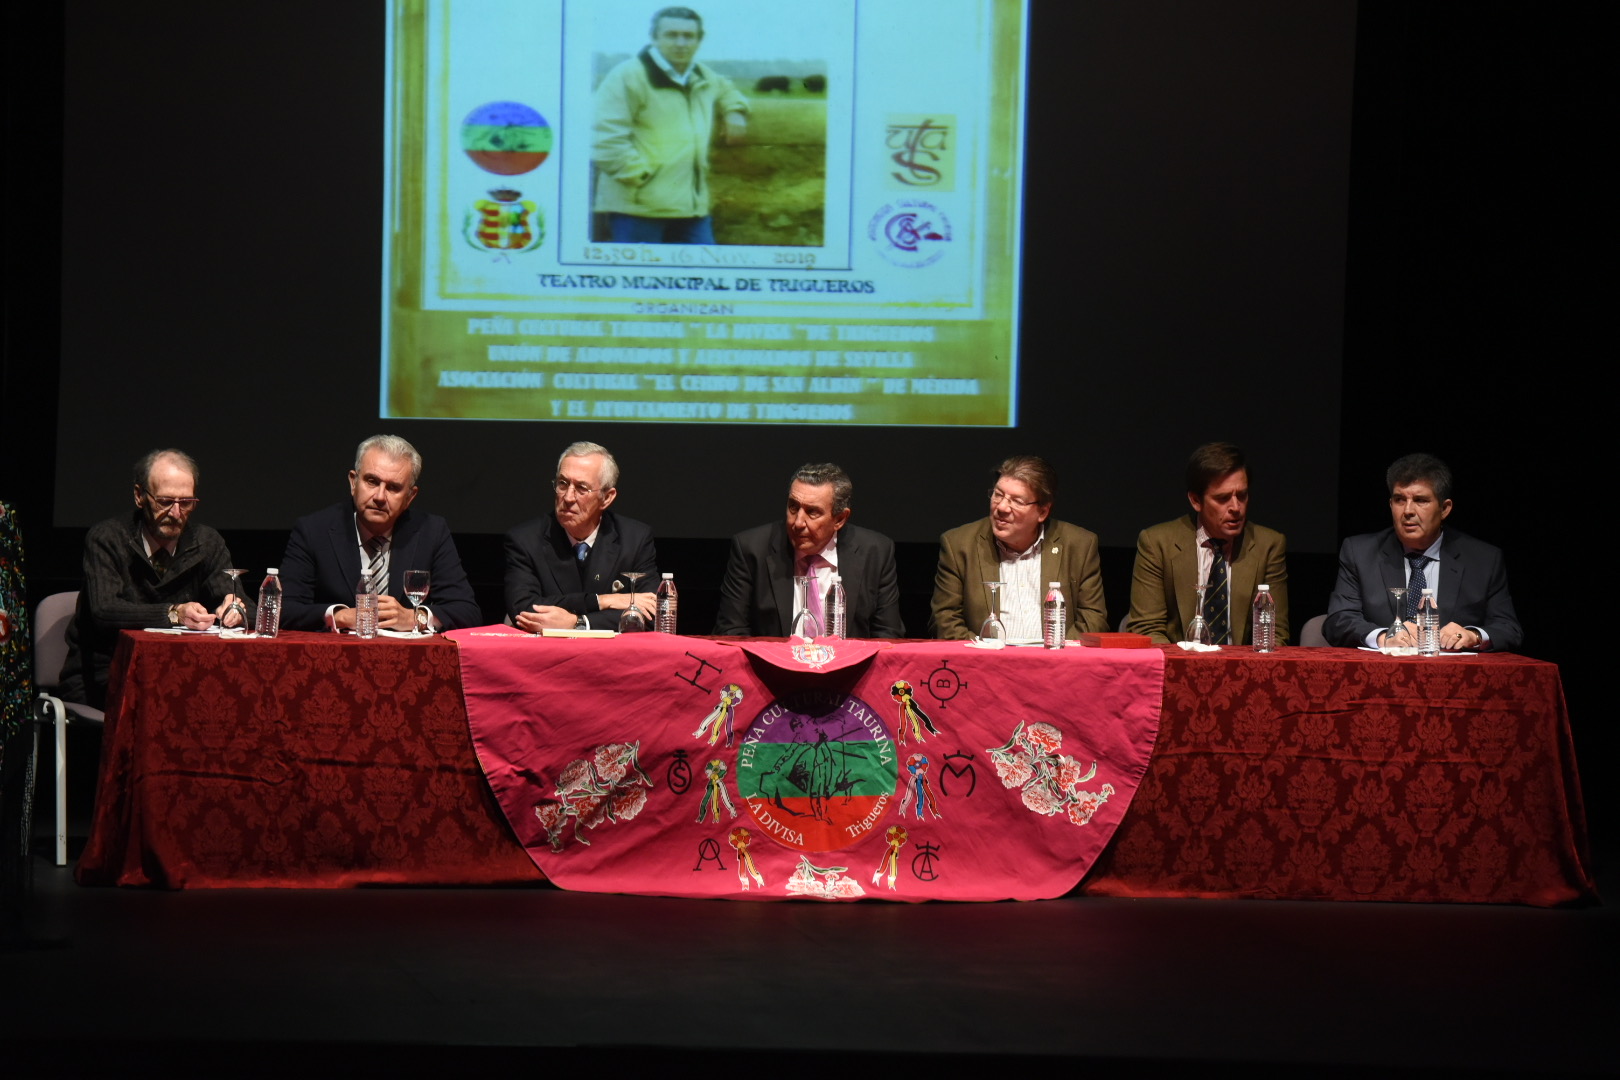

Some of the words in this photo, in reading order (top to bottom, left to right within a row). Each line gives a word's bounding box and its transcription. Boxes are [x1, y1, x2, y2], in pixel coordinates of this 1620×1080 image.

[537, 273, 617, 289] TEATRO
[622, 275, 730, 292] MUNICIPAL
[735, 278, 762, 292] DE
[769, 279, 876, 294] TRIGUEROS
[631, 302, 735, 316] ORGANIZAN
[741, 726, 766, 769] PEÑA
[846, 699, 893, 766] TAURINA
[745, 792, 763, 816] LA
[758, 811, 805, 847] DIVISA
[845, 791, 891, 839] Trigueros
